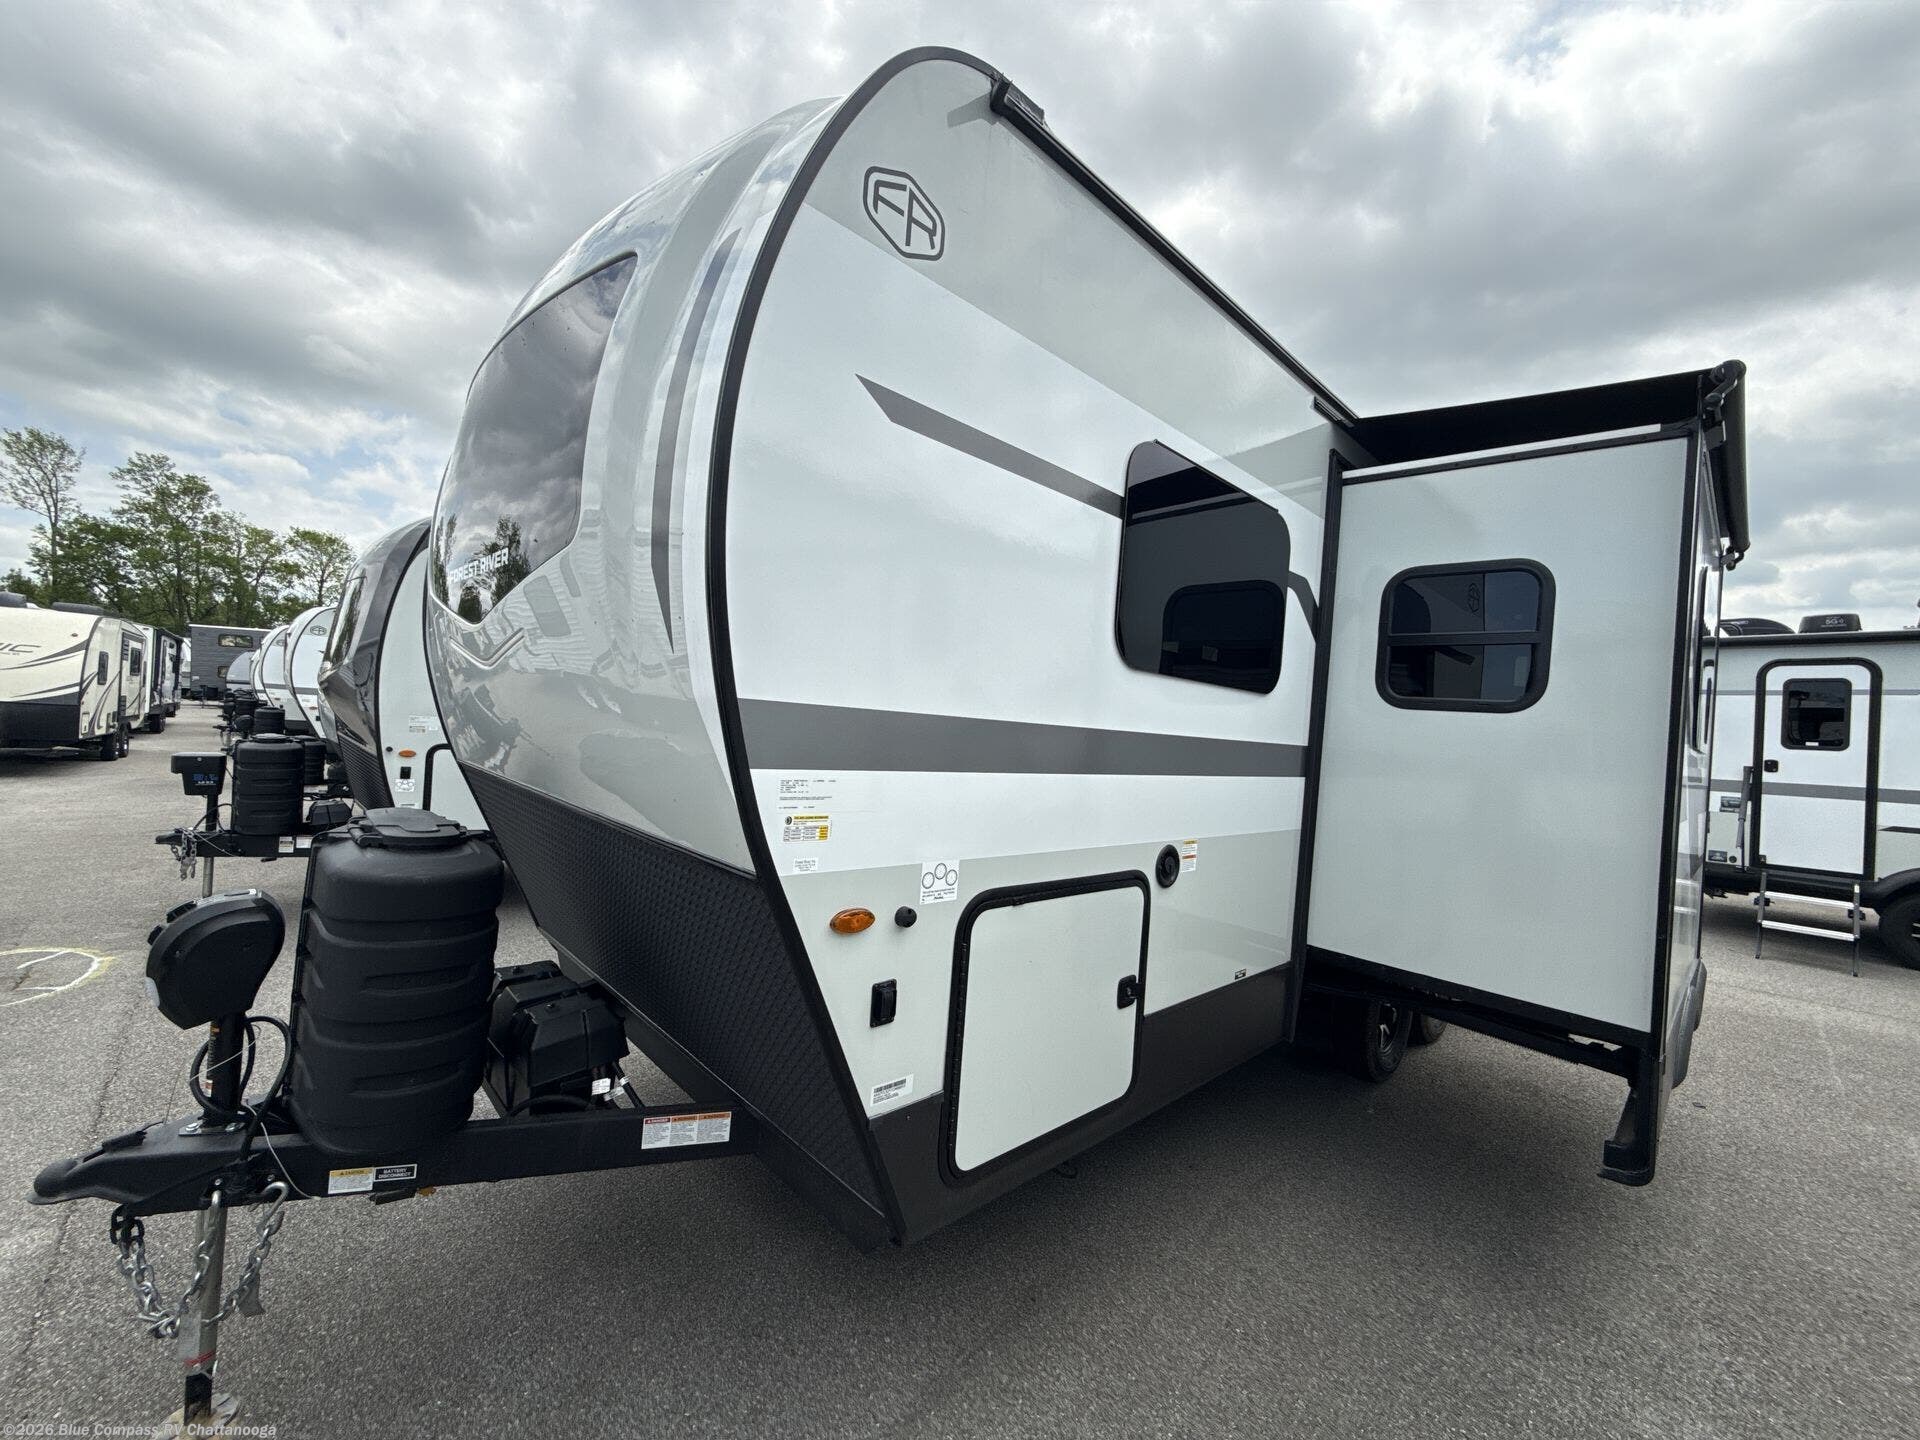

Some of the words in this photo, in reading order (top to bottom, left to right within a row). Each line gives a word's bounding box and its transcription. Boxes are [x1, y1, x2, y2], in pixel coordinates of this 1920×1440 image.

[449, 560, 479, 584] FOREST
[480, 547, 509, 574] RIVER
[0, 642, 42, 653] IC
